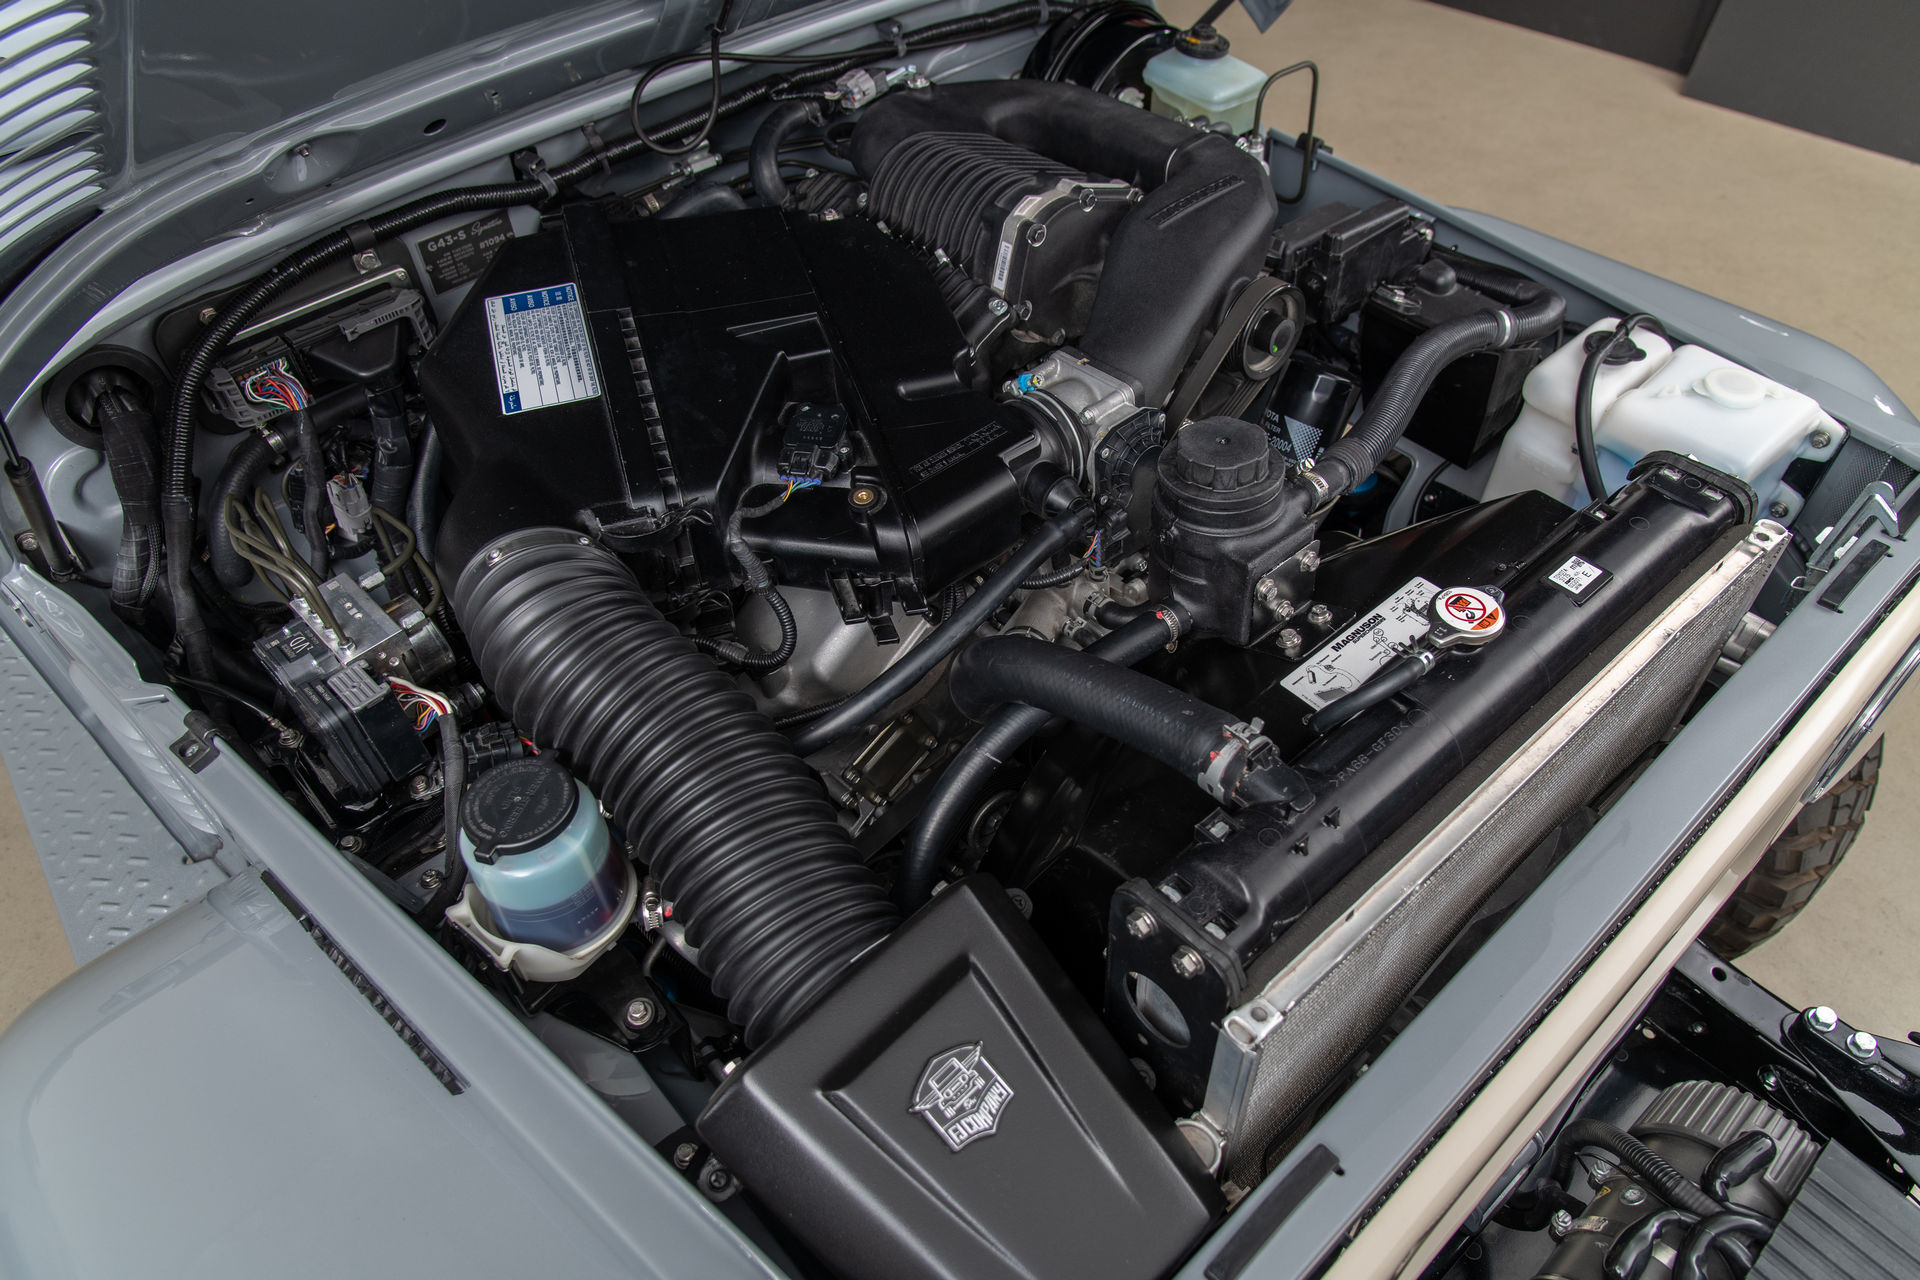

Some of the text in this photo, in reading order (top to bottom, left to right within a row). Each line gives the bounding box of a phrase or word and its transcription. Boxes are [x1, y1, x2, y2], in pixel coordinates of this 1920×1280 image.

[427, 230, 467, 252] G43-S
[526, 294, 536, 308] AVISO
[541, 290, 551, 307] NOTICE
[565, 285, 575, 302] NOTICE
[1331, 612, 1384, 652] MAGNUSON
[947, 1081, 1008, 1144] FJ COMPANY
